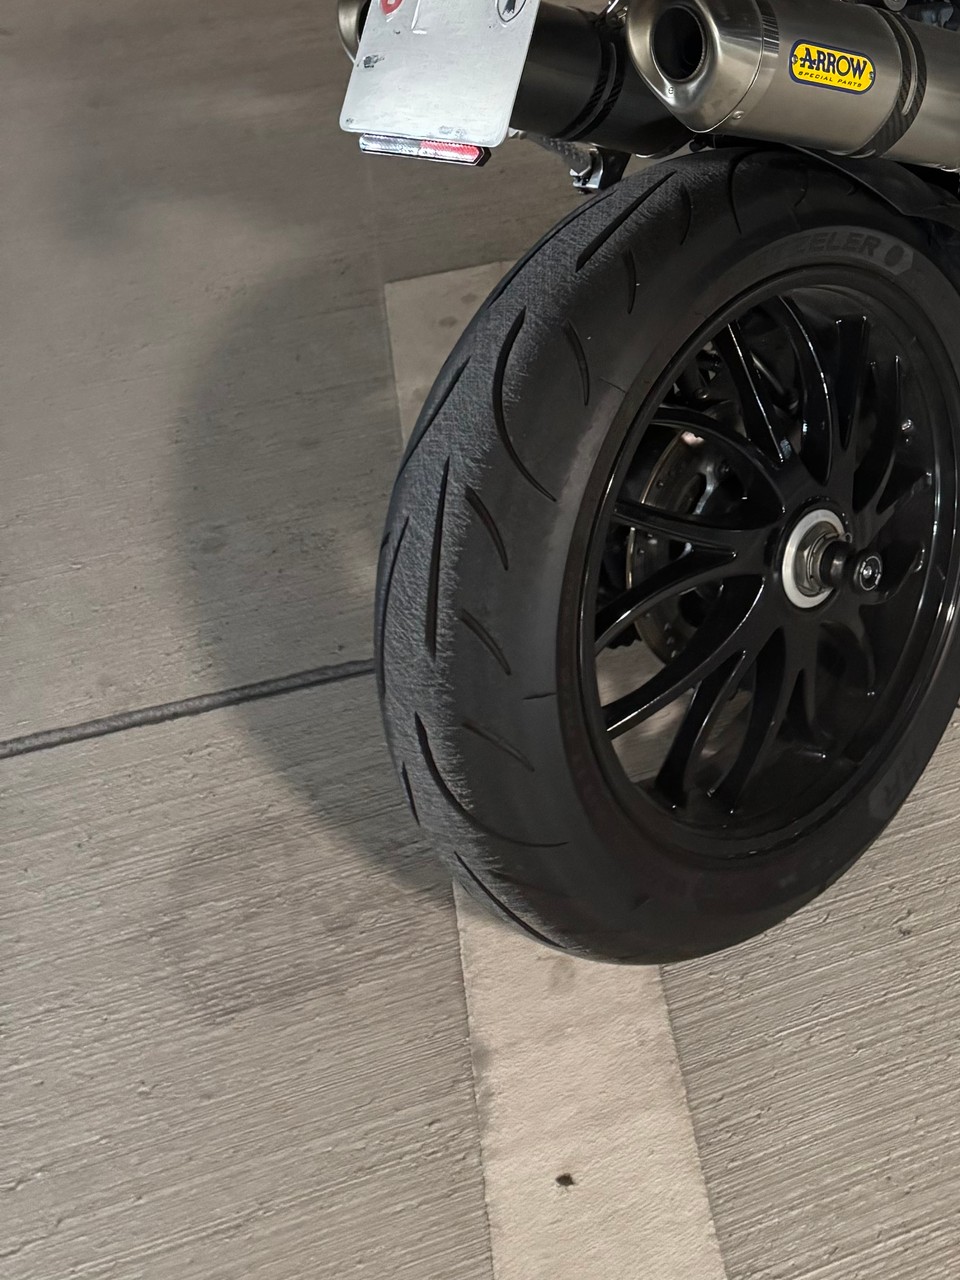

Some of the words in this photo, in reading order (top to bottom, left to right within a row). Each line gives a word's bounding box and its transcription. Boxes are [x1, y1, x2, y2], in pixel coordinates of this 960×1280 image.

[800, 48, 868, 80] ARROW
[798, 70, 833, 83] SPECIAL
[837, 79, 863, 88] PARTS
